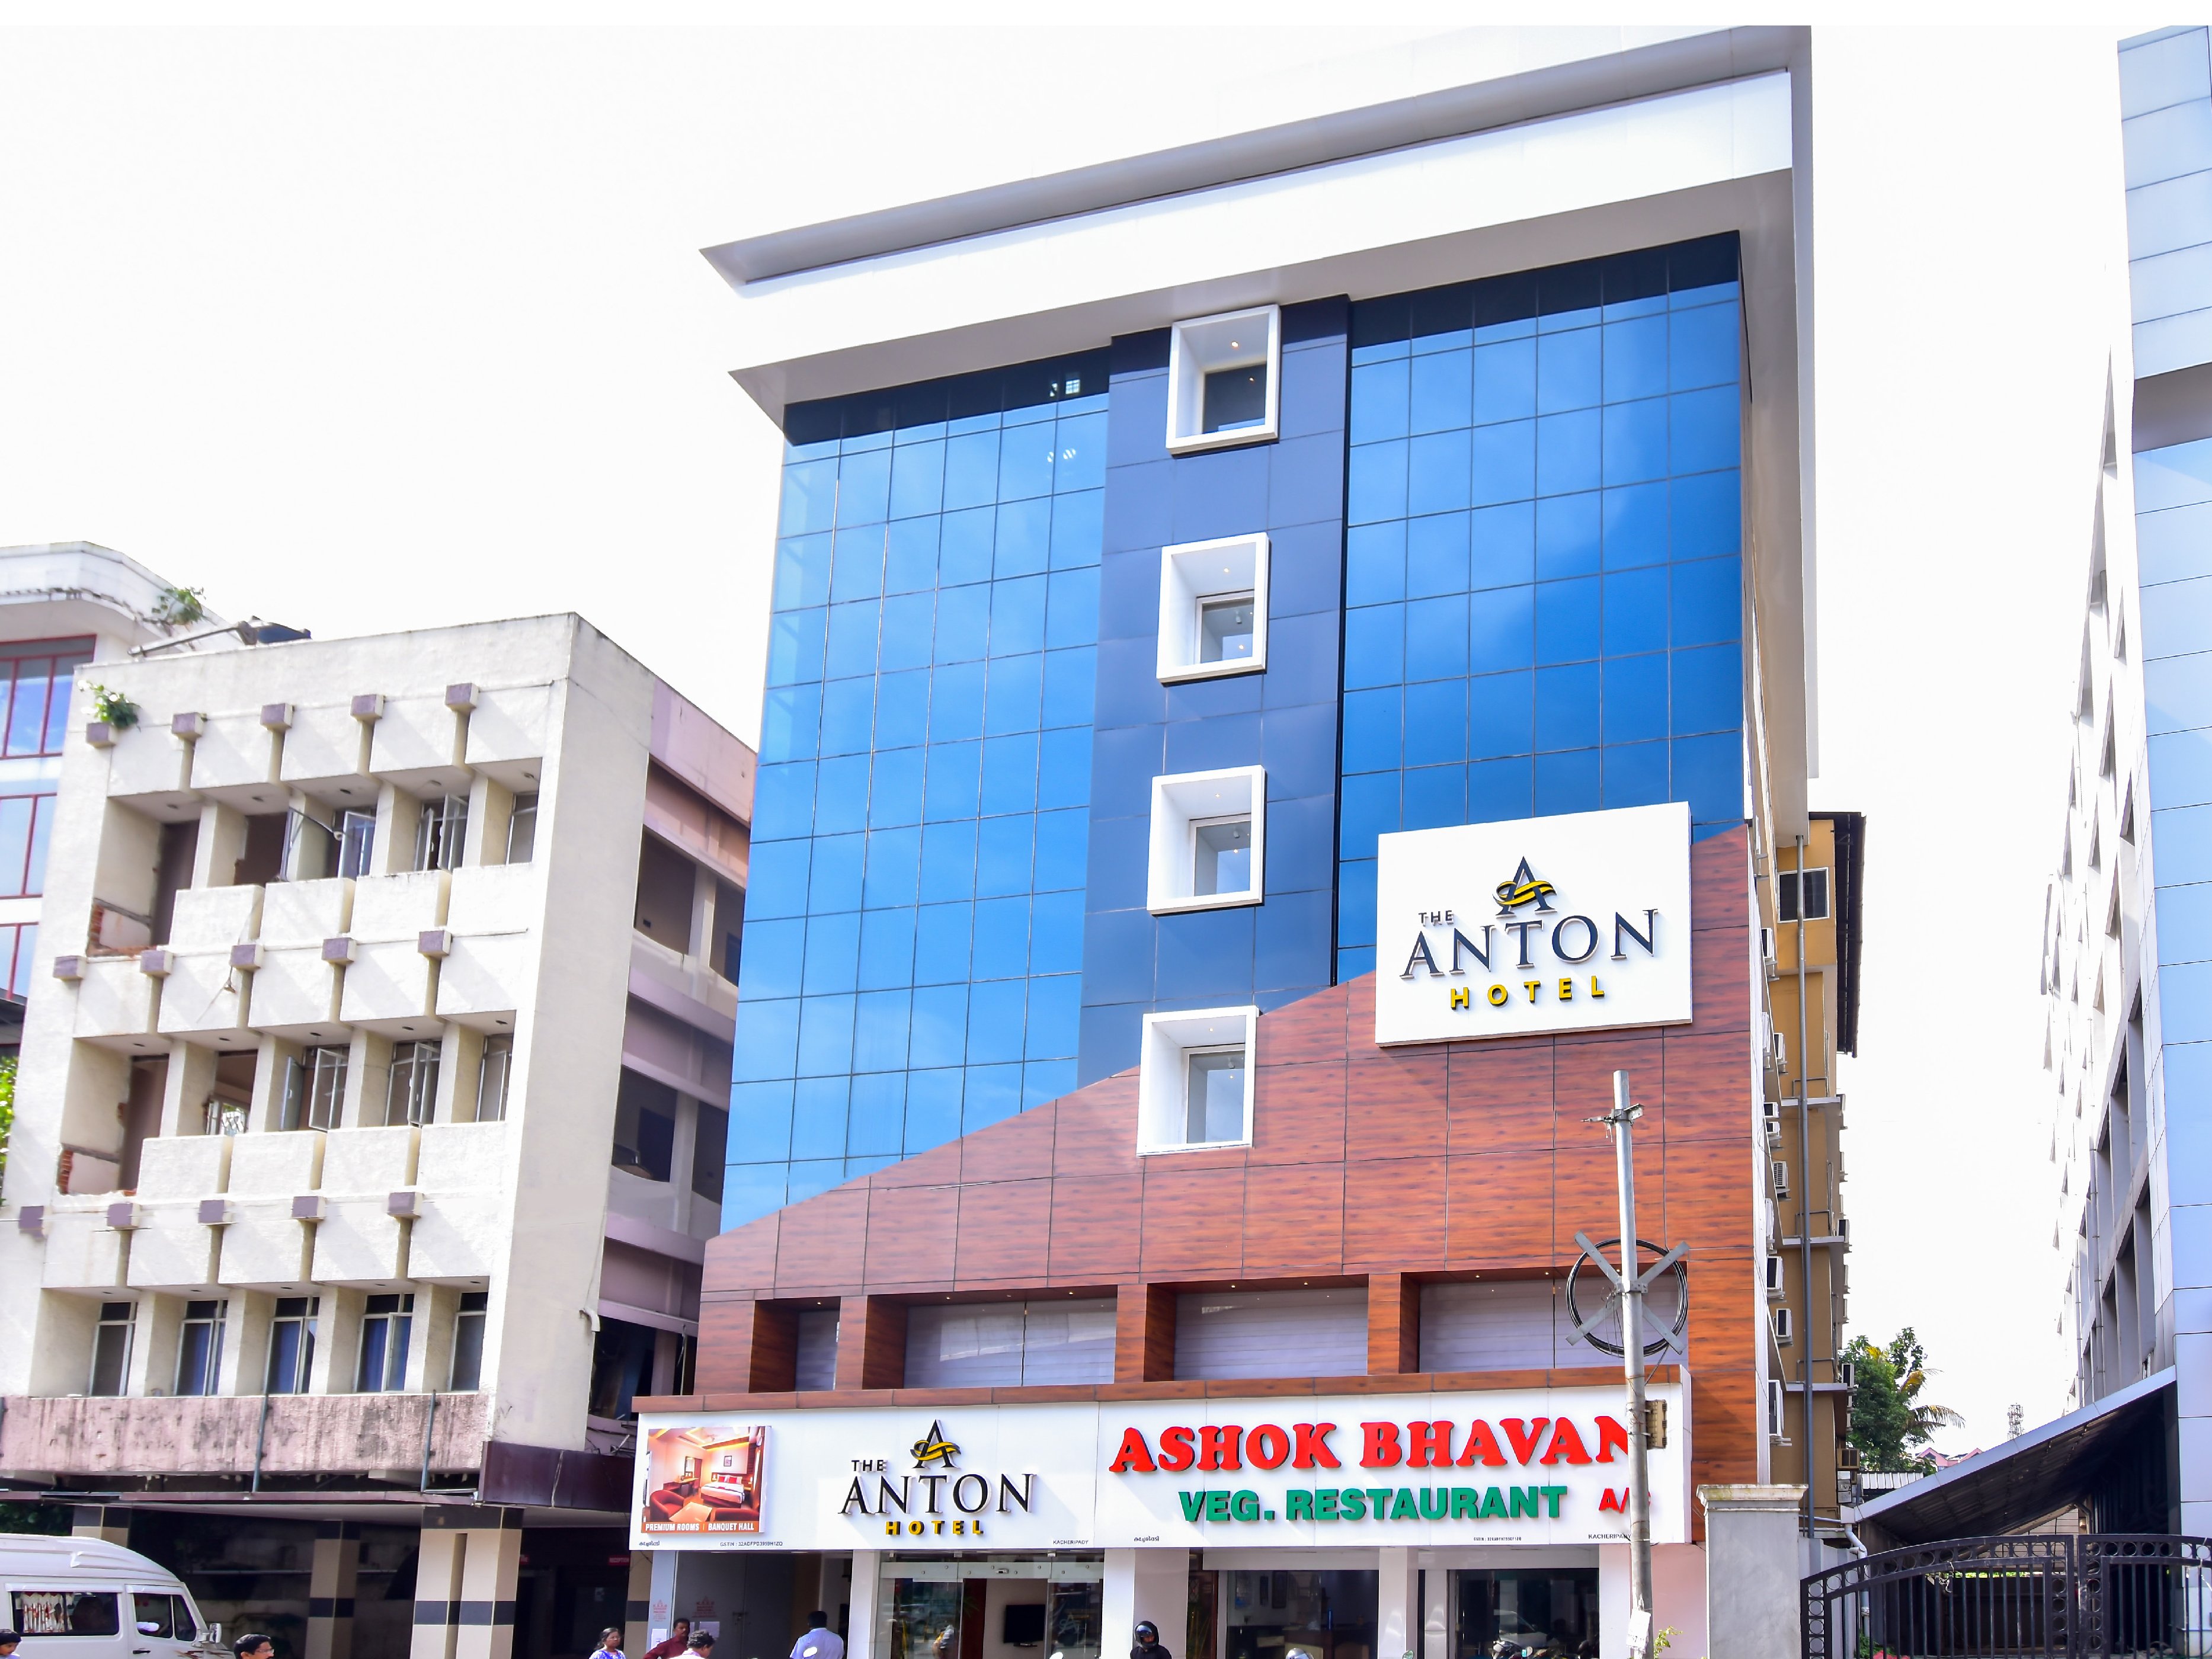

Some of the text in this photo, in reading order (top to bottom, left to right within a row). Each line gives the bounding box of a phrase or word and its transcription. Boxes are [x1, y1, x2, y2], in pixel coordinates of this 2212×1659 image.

[1419, 909, 1454, 925] THE
[1400, 908, 1659, 979] ANTON
[1449, 975, 1605, 1010] HOTEL
[1109, 1415, 1630, 1473] ASHOK BHAVAN
[851, 1459, 888, 1472] THE
[837, 1473, 1035, 1516] ANTON
[1178, 1490, 1275, 1522] VEG.
[1285, 1485, 1568, 1521] RESTAURANT
[645, 1522, 755, 1532] PREMIUM ROOMS BANQUET HALL
[885, 1520, 984, 1536] HOTEL
